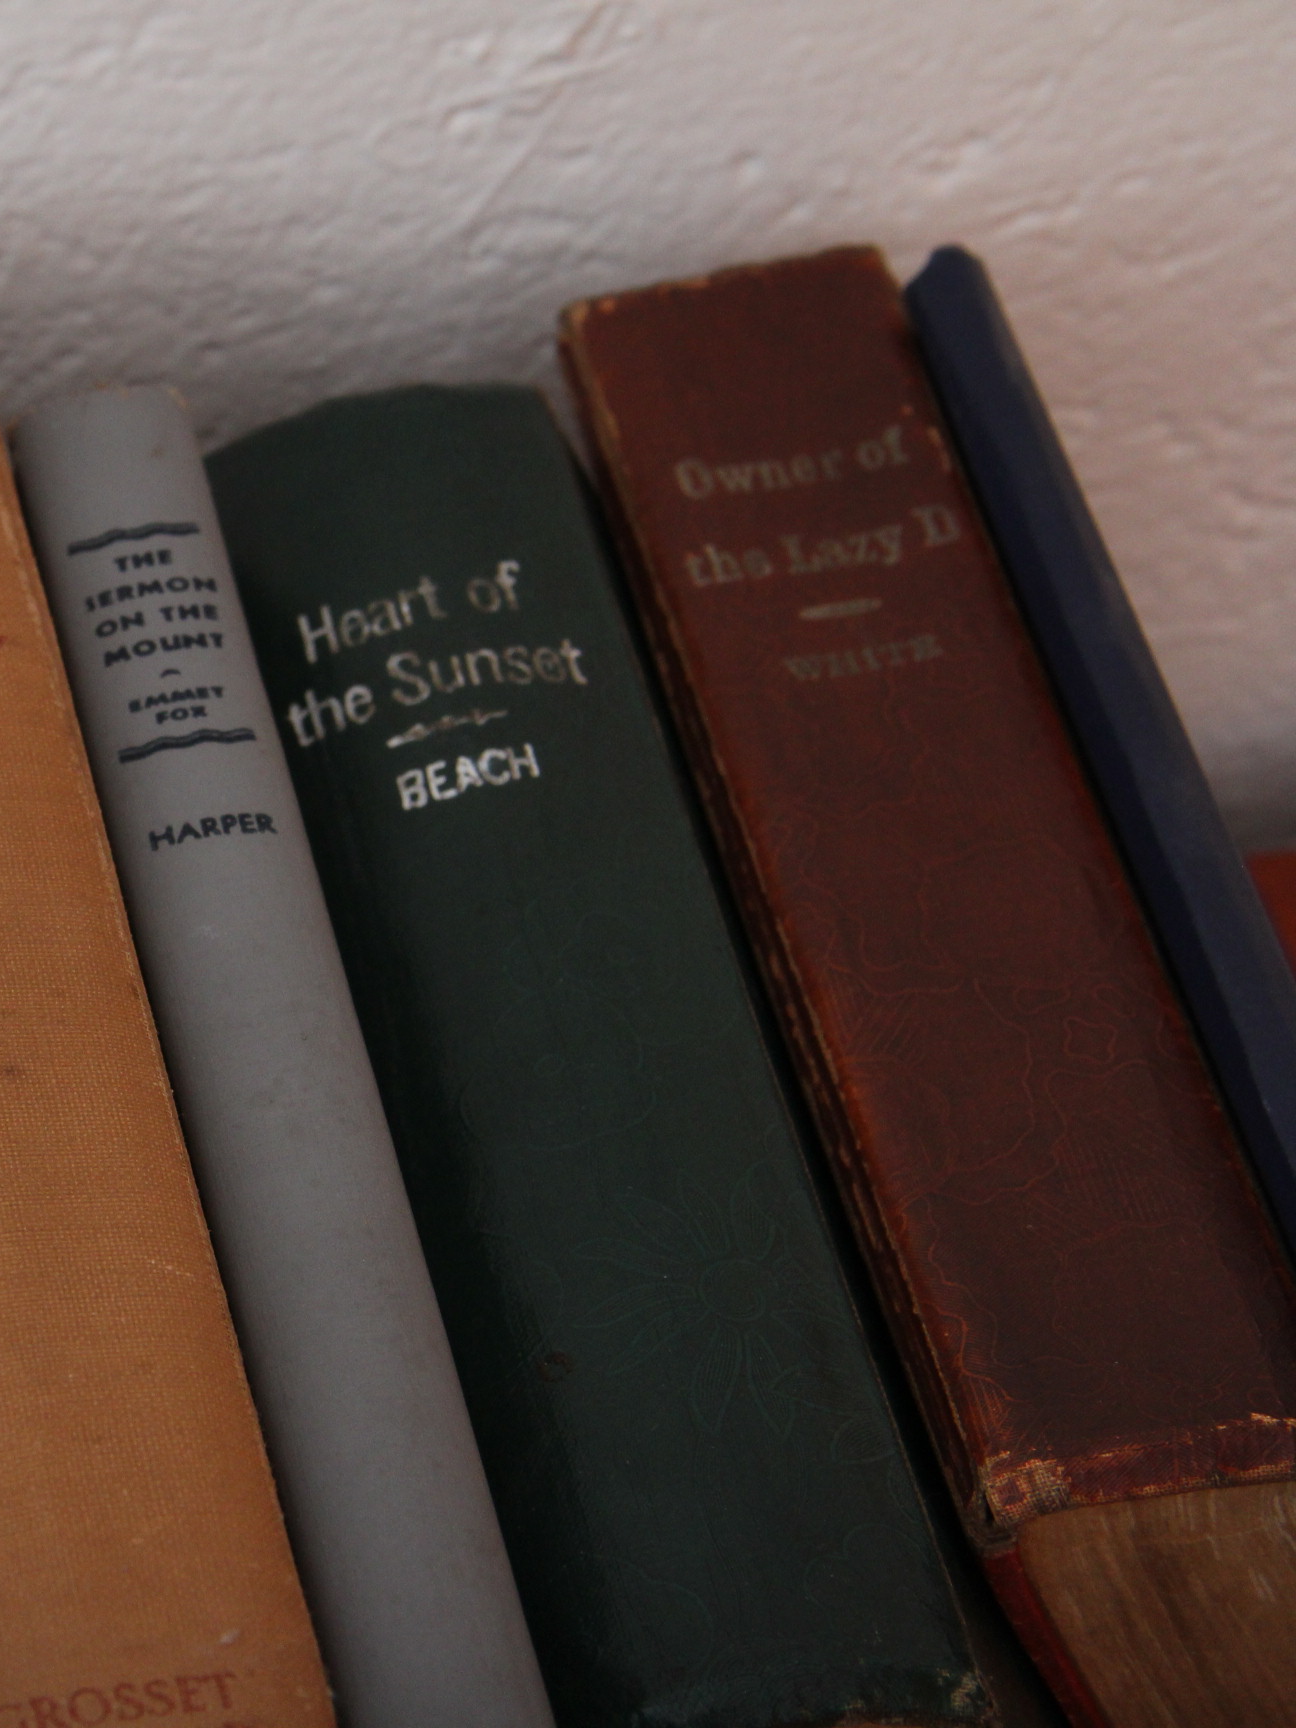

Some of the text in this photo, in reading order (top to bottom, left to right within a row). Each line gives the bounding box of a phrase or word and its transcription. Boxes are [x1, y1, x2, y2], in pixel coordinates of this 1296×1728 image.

[676, 424, 909, 499] Owner of
[114, 549, 172, 573] THE
[685, 543, 774, 588] the
[780, 524, 903, 575] Lazy
[85, 576, 218, 613] SERMON
[297, 559, 520, 664] Heart of
[95, 604, 219, 638] ON THE
[104, 632, 224, 667] MOUNT
[129, 686, 224, 713] EMMET
[289, 638, 589, 747] the Sunset
[155, 705, 208, 725] FOX
[396, 743, 540, 811] BEACH
[149, 813, 278, 851] HARPER
